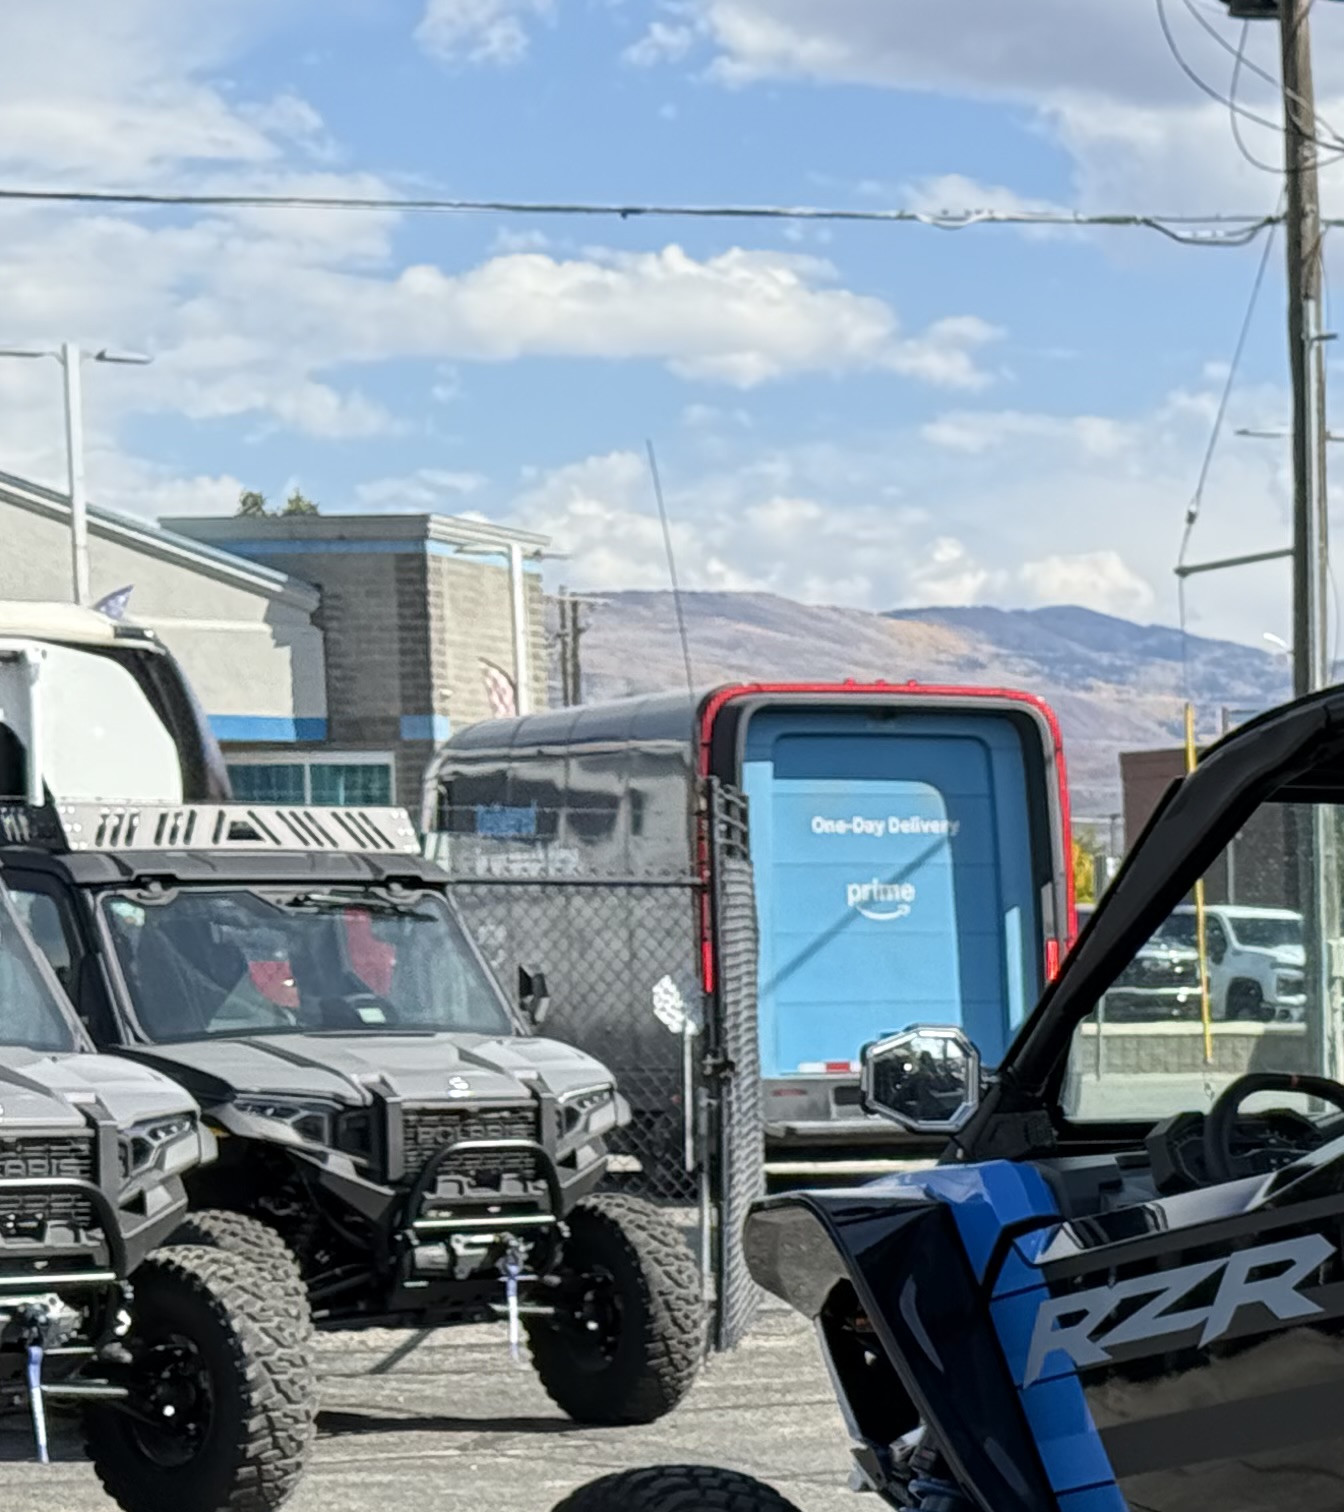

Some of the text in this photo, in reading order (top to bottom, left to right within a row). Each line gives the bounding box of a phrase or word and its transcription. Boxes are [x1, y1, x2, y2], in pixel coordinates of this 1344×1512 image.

[811, 815, 960, 837] One-Day Delivery
[847, 877, 915, 906] prime
[418, 1124, 527, 1143] POLARIS
[1022, 1232, 1337, 1390] RZR
